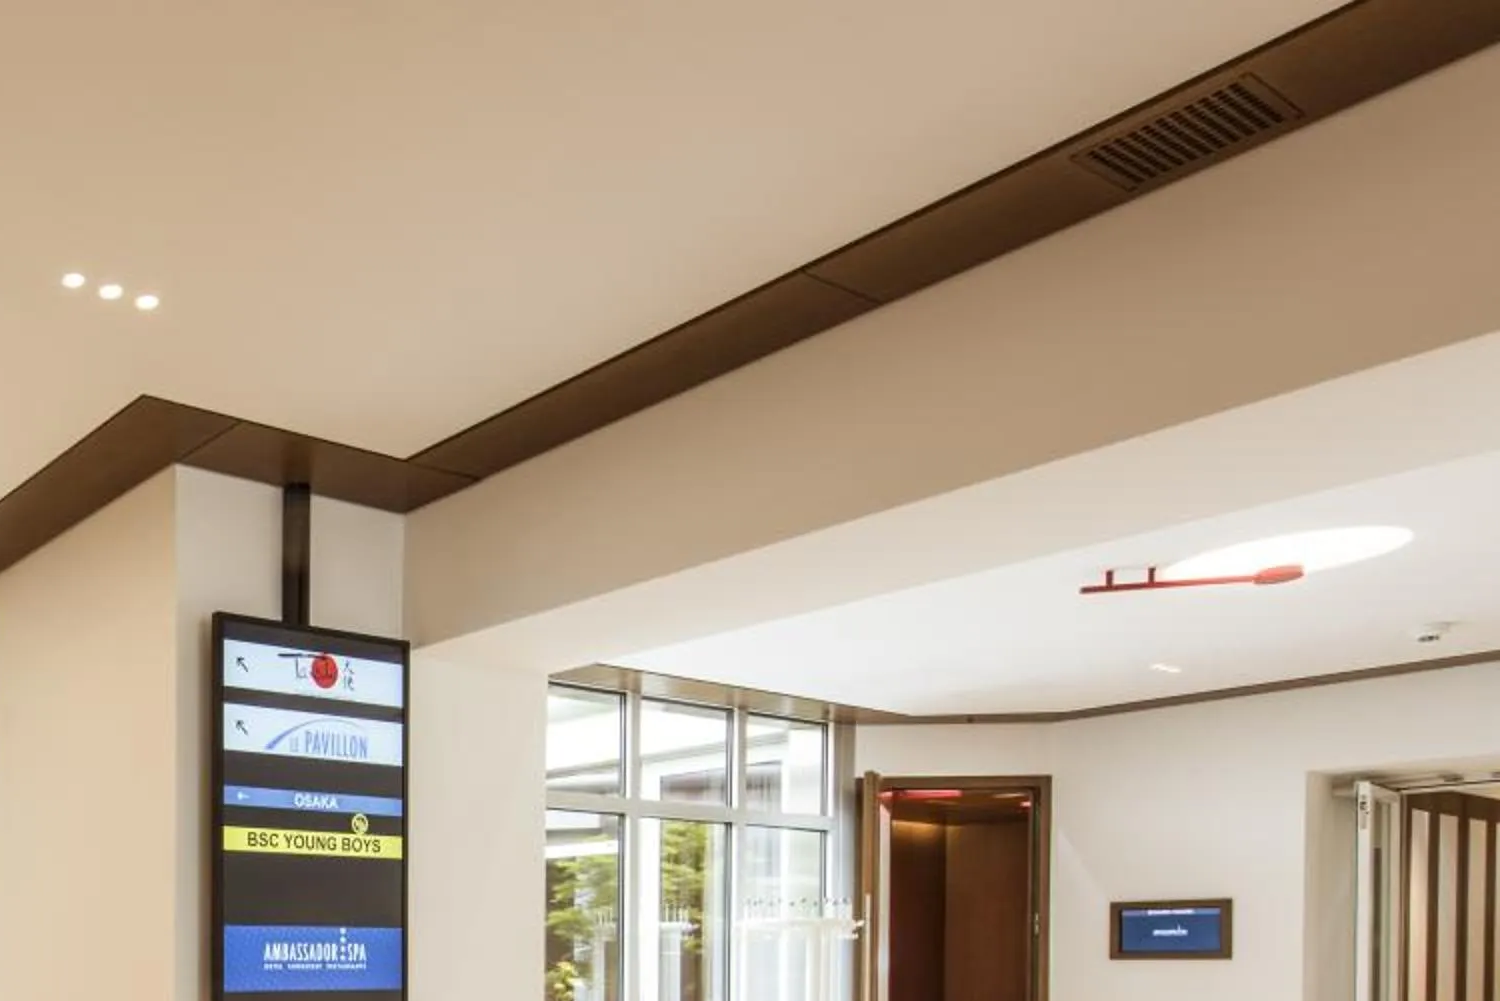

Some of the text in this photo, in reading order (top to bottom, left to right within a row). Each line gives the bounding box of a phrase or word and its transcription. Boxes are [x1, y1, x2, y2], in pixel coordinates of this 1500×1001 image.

[304, 730, 368, 759] PAVILLON
[293, 793, 339, 809] OSAKA
[247, 831, 381, 853] BSC YOUNG BOYS
[263, 943, 367, 961] AMBASSADOR SPA
